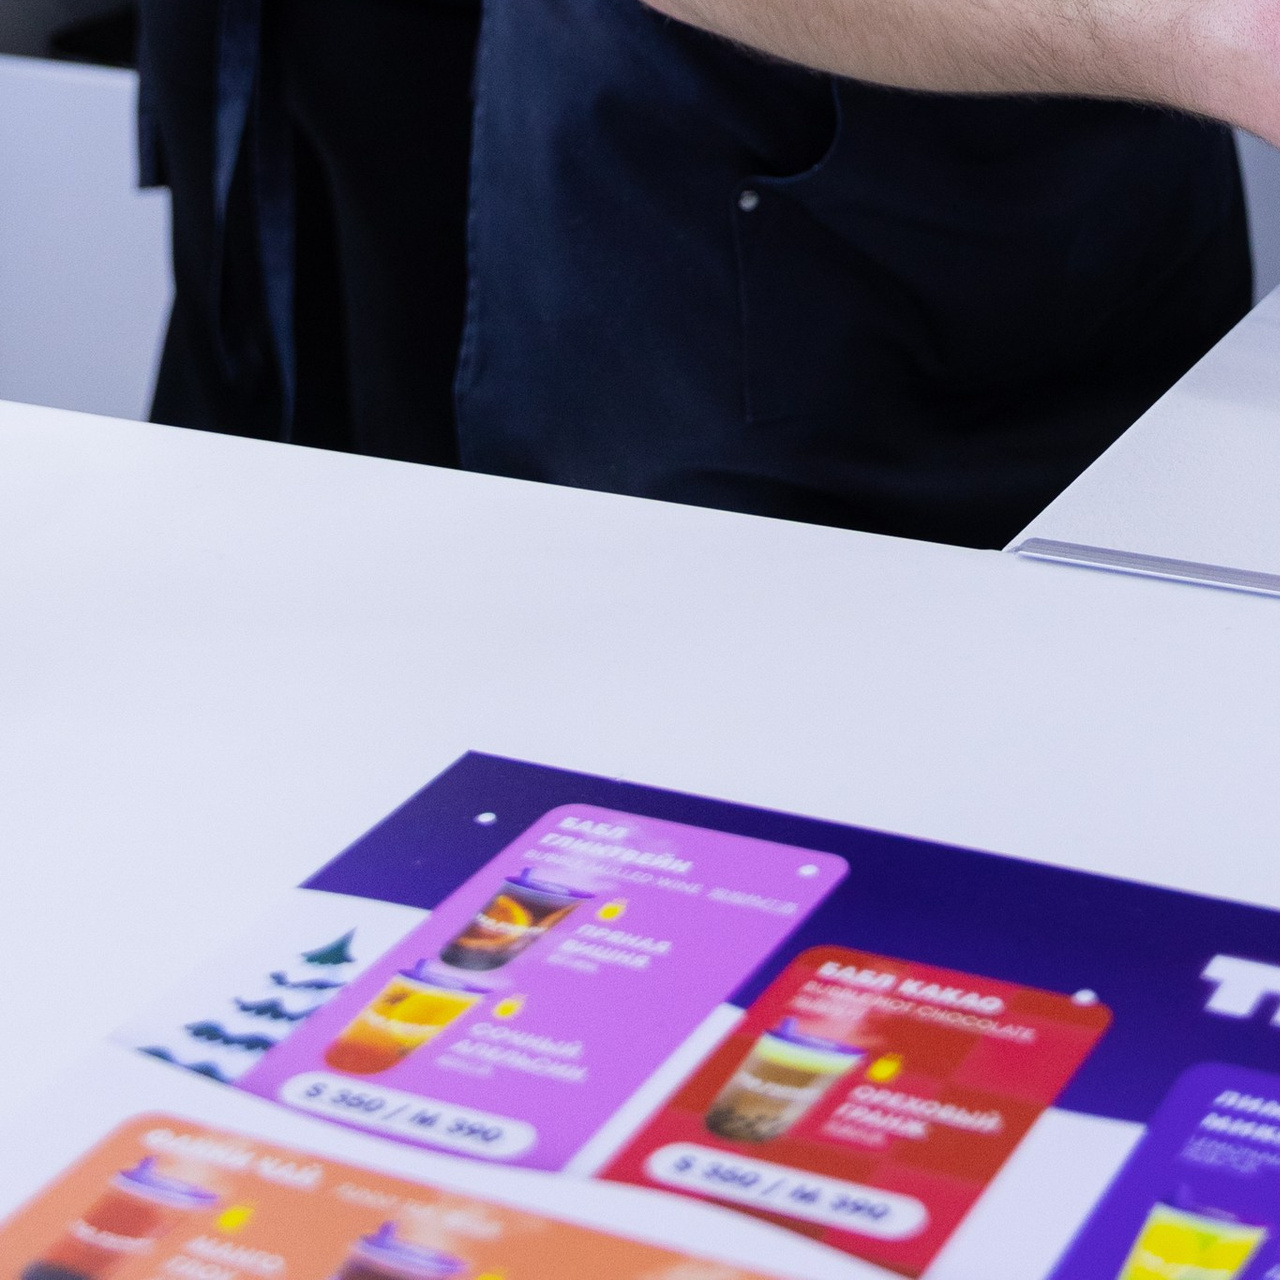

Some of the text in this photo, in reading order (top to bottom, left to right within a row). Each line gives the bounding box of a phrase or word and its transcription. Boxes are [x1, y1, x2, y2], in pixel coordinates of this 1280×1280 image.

[557, 816, 632, 841] БАБЛ
[537, 832, 694, 874] ГЛИНТВЕЙН
[652, 874, 705, 896] WINE
[815, 960, 896, 991] БАБЛ
[898, 979, 1006, 1016] КАКАО
[914, 1003, 1037, 1043] CHOCOLATE
[850, 1084, 1004, 1135] ОРЕХОВЫЙ
